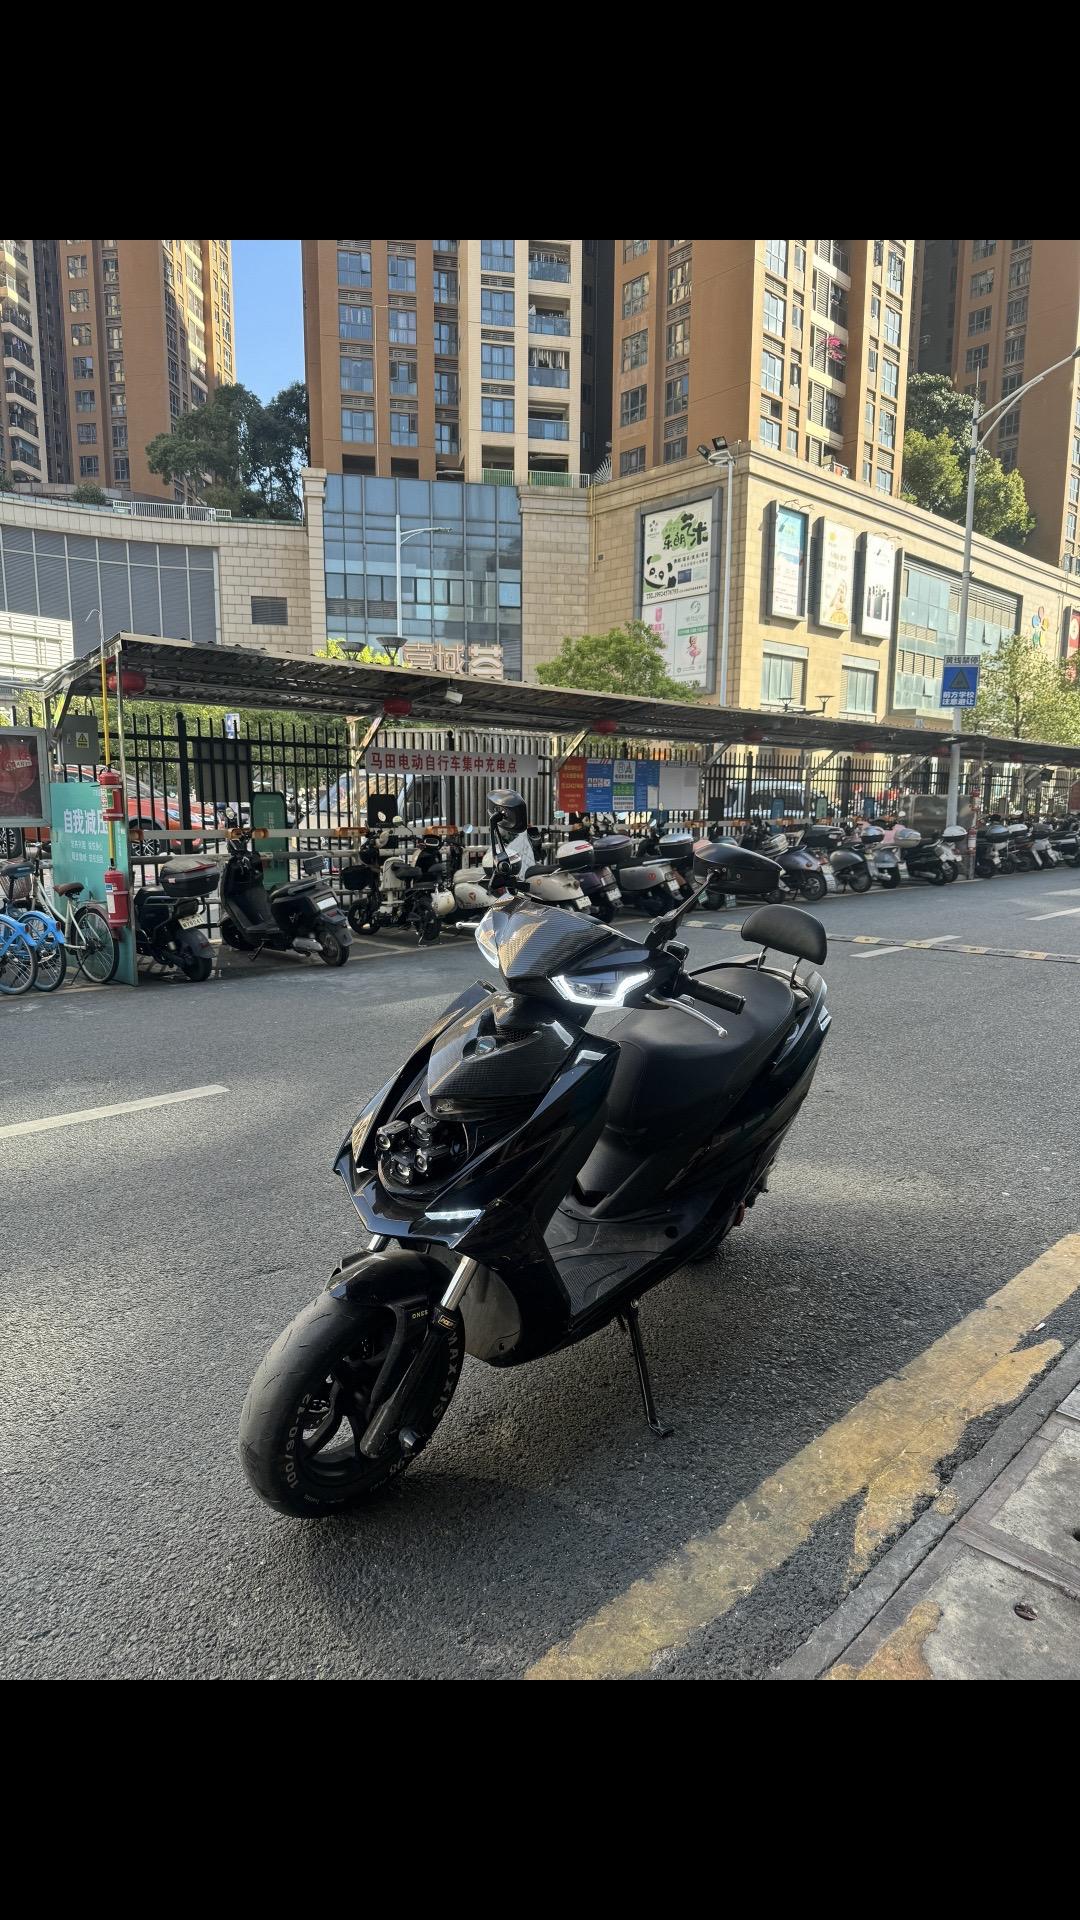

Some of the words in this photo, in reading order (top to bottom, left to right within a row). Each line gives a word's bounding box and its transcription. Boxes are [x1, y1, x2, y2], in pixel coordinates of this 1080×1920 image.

[946, 656, 979, 664] 黄线禁停
[943, 691, 975, 699] 前方学校
[371, 752, 517, 774] 马田电动自行车集中充电点
[411, 1309, 429, 1320] ONES
[432, 1331, 459, 1418] MAXXIS
